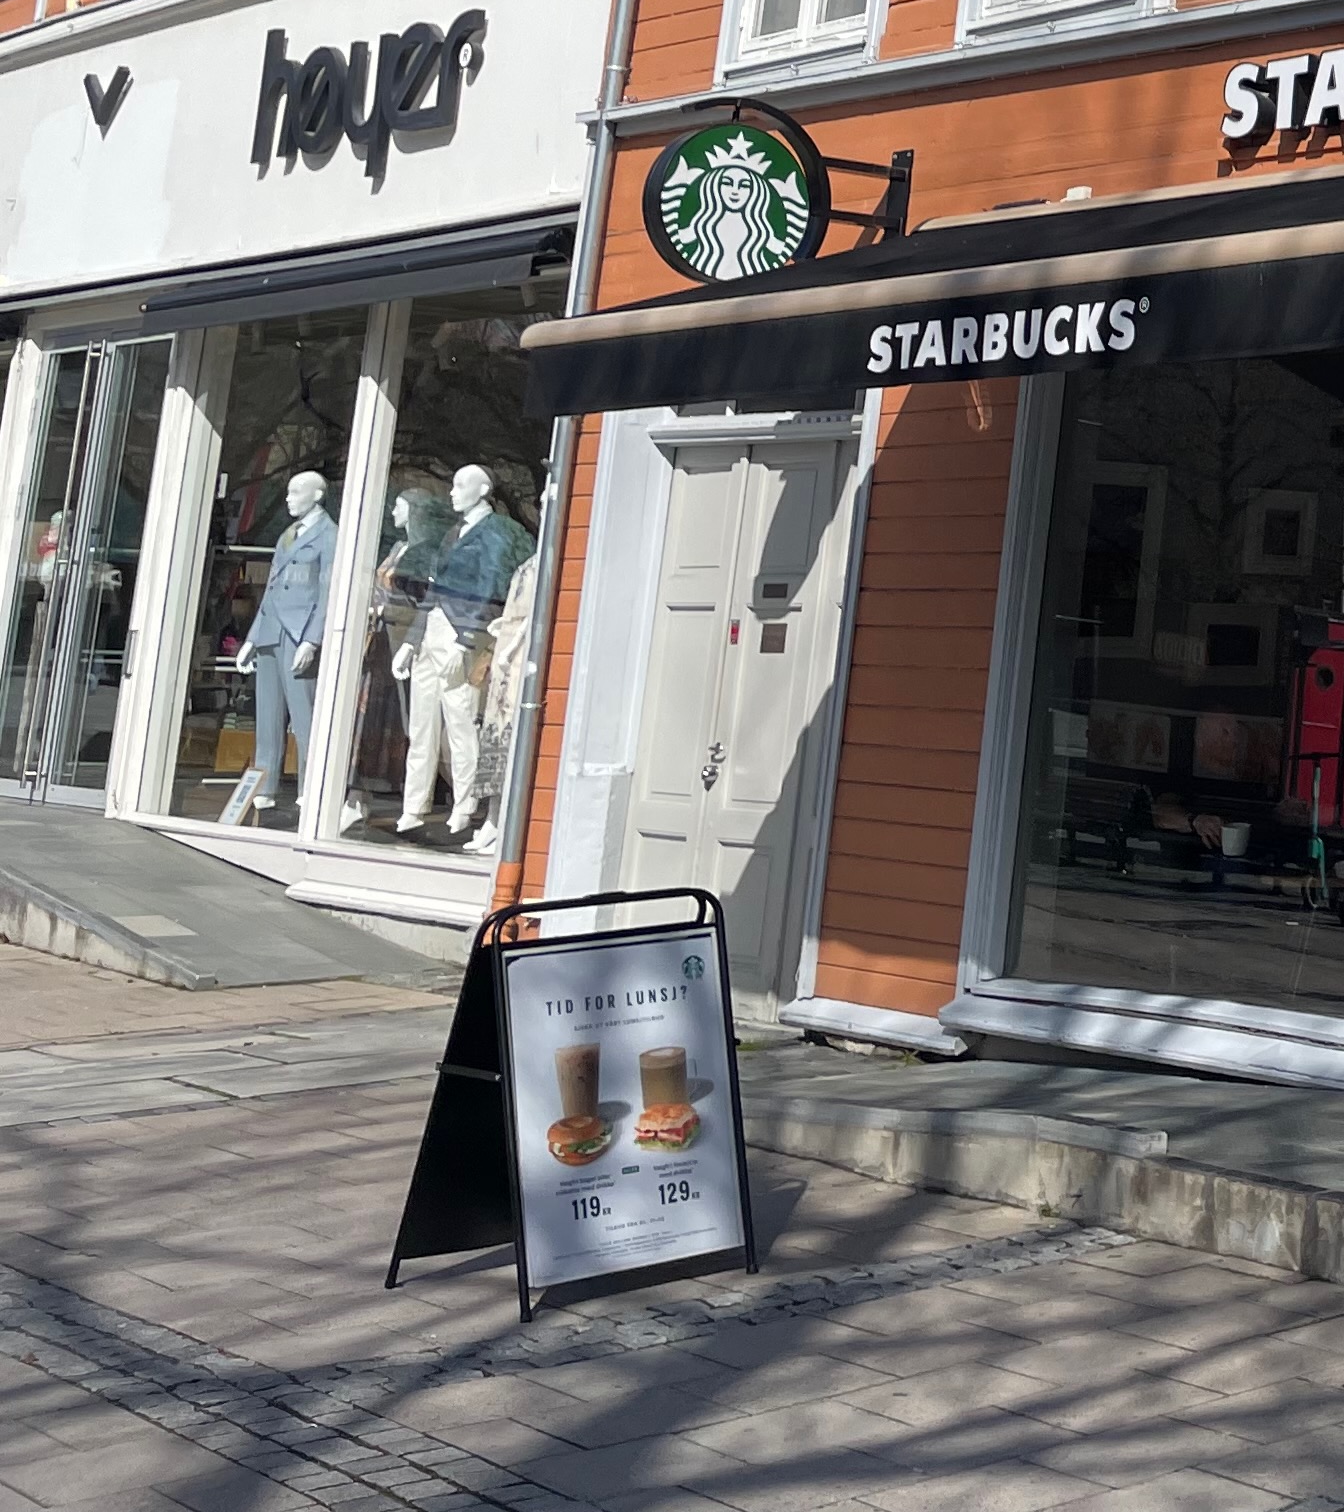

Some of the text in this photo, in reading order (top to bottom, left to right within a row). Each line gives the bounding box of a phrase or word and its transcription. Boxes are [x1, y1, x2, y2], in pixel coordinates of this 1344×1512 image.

[545, 985, 688, 1017] TID FOR LUNSJ?
[658, 1180, 690, 1205] 129
[571, 1196, 601, 1221] 119
